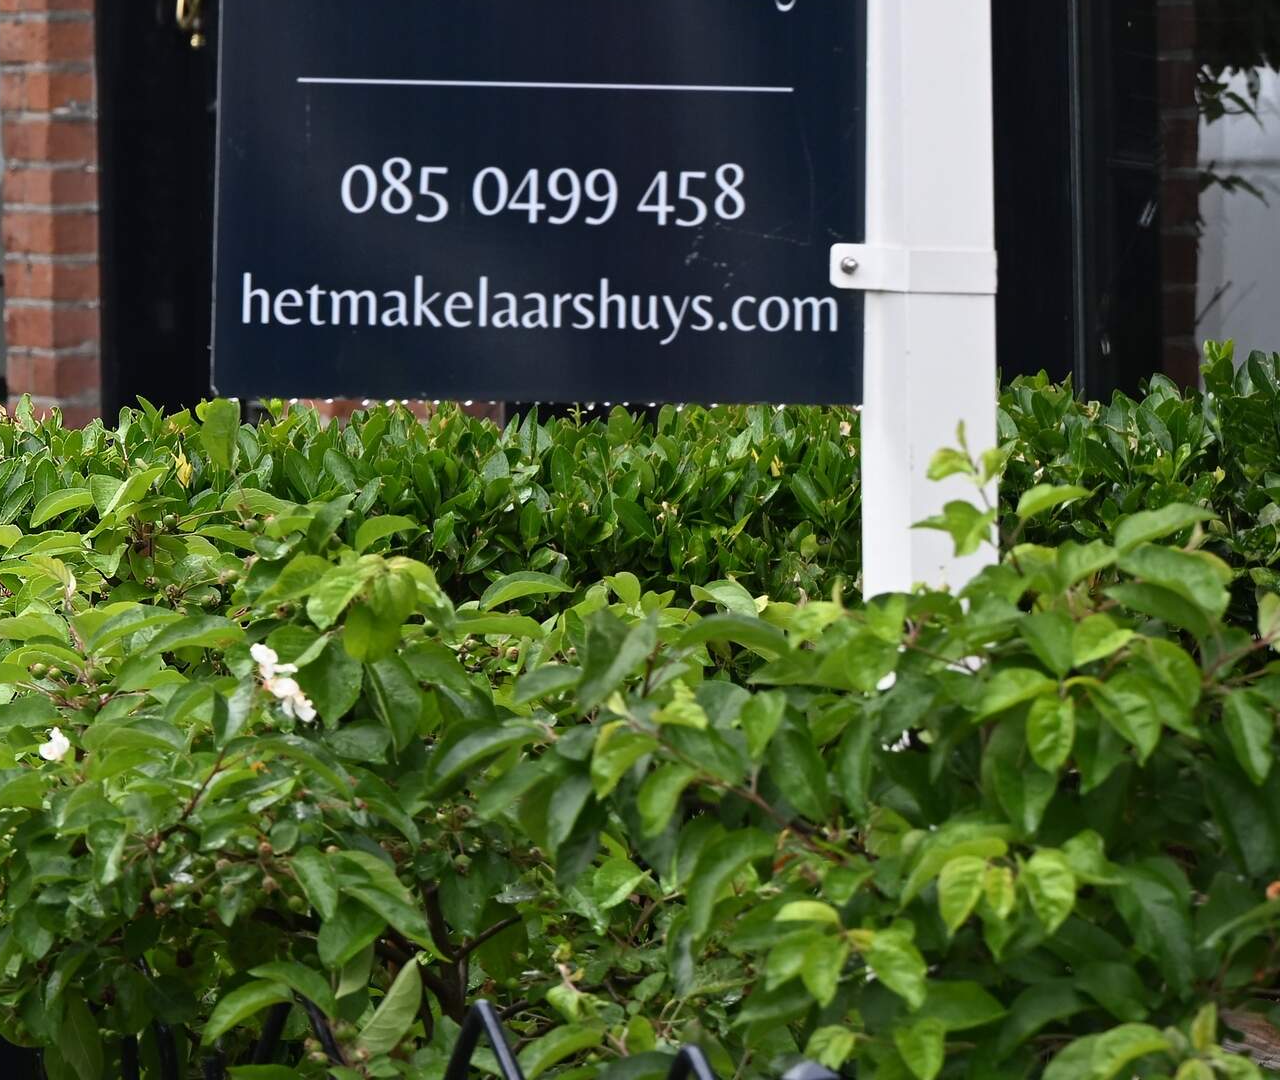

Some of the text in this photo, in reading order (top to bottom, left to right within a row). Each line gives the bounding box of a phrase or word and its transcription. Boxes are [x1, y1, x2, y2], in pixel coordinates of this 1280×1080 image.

[340, 156, 747, 228] 085 0499 458
[241, 272, 840, 346] hetmakelaarshuys.com
